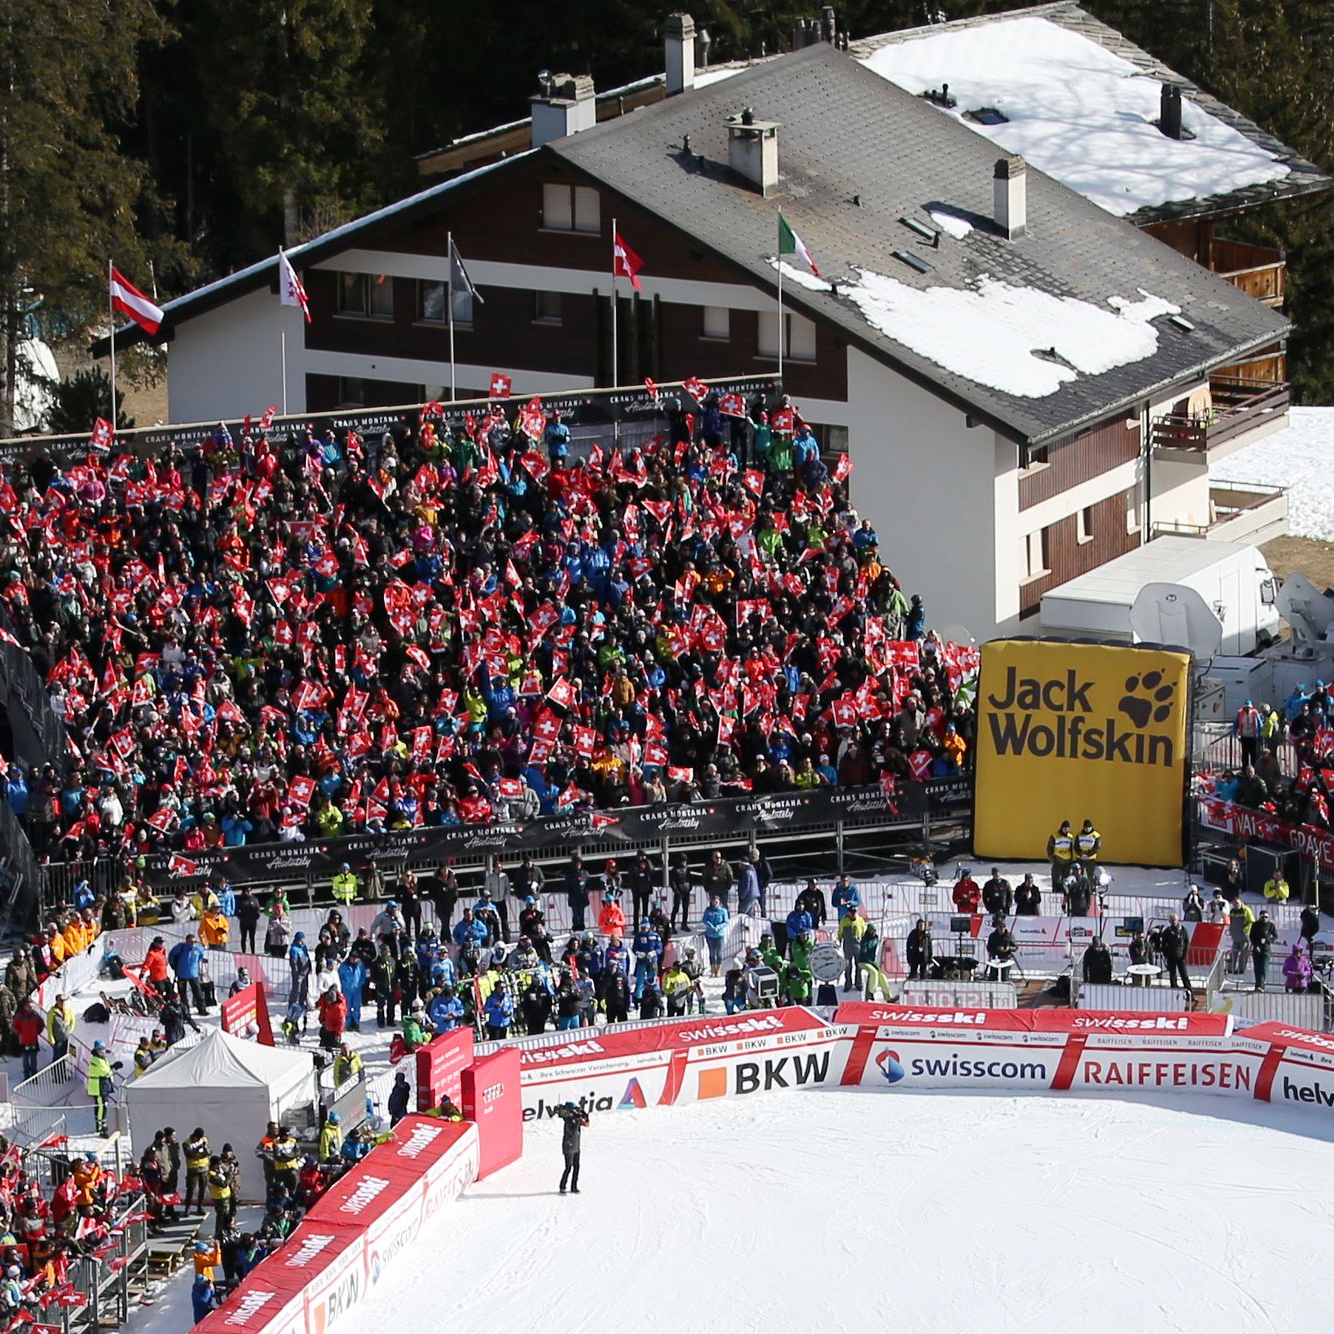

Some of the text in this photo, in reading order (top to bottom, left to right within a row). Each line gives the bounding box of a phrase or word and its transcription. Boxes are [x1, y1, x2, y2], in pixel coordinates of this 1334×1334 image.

[987, 666, 1095, 712] Jack
[987, 712, 1173, 768] Wolfskin
[678, 1014, 786, 1043] swissski
[869, 1010, 987, 1025] swissski
[1072, 1016, 1189, 1030] swissski
[745, 1038, 767, 1050] BKW
[785, 1033, 807, 1045] BKW
[825, 1026, 847, 1038] BKW
[705, 1044, 727, 1056] BKW
[735, 1050, 831, 1095] BKW
[911, 1053, 1046, 1080] swisscom
[1084, 1061, 1251, 1091] RAIFFEISEN
[223, 1290, 275, 1326] swissski
[327, 1272, 359, 1328] BKW
